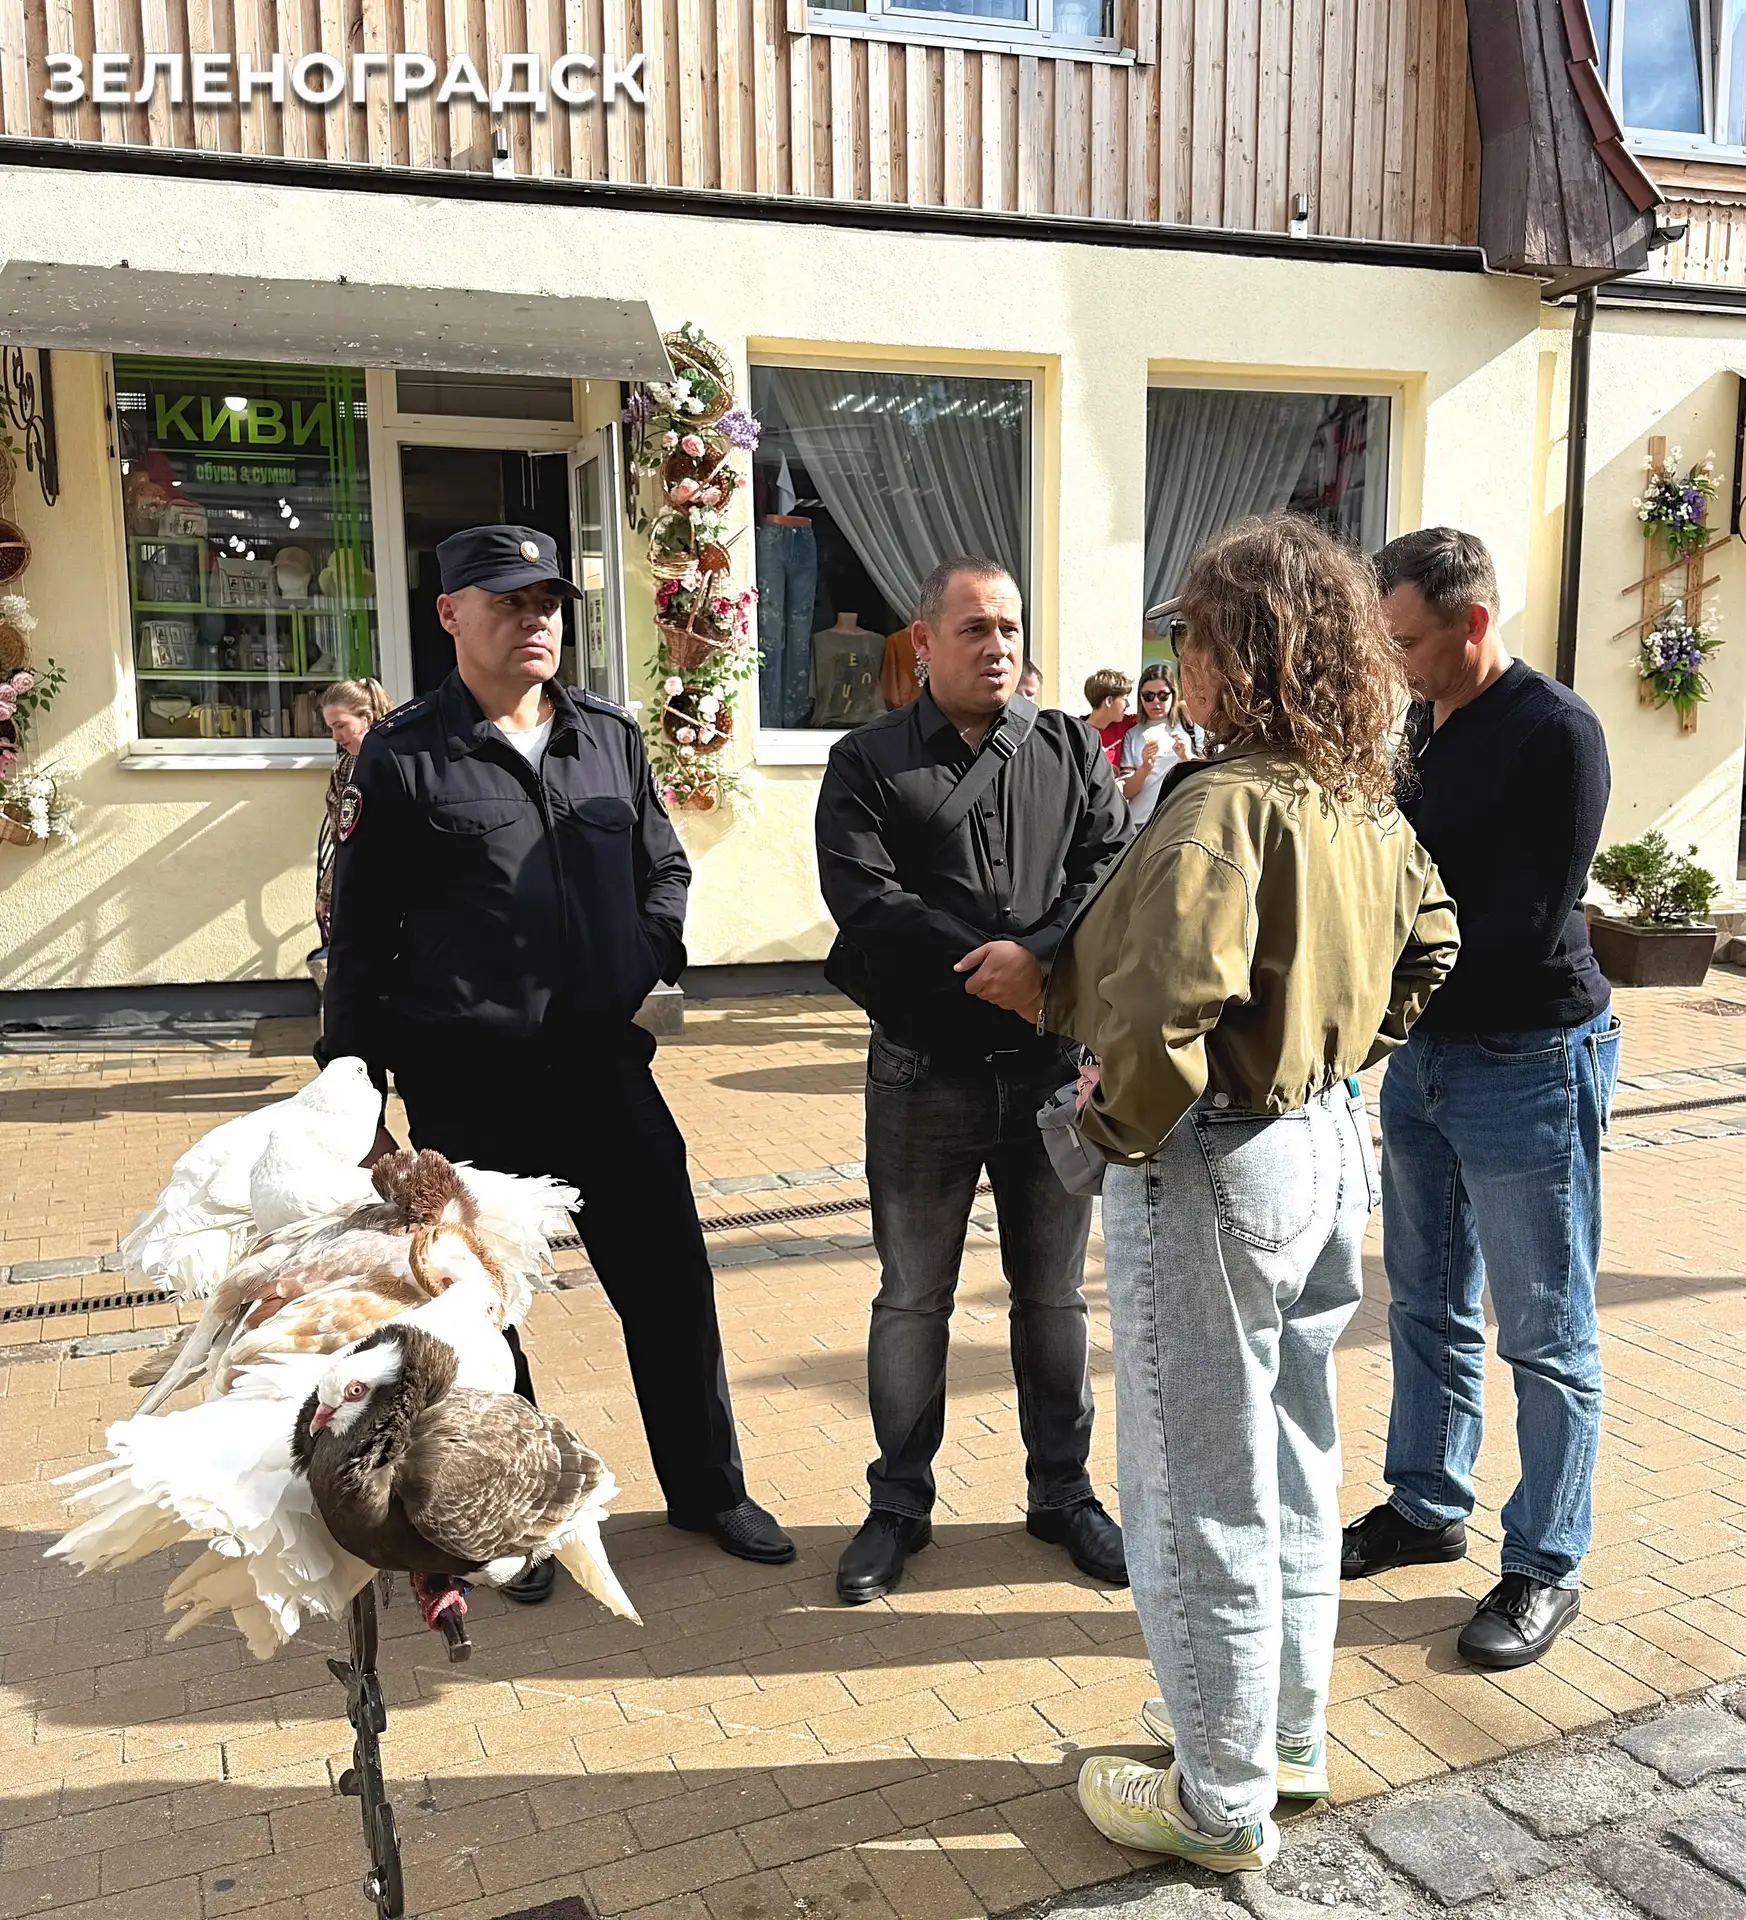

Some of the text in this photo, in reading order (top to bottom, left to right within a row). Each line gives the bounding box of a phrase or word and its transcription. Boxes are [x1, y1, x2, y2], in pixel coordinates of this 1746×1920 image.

[155, 394, 331, 447] КИВИ
[196, 462, 295, 484] обувь & сумки
